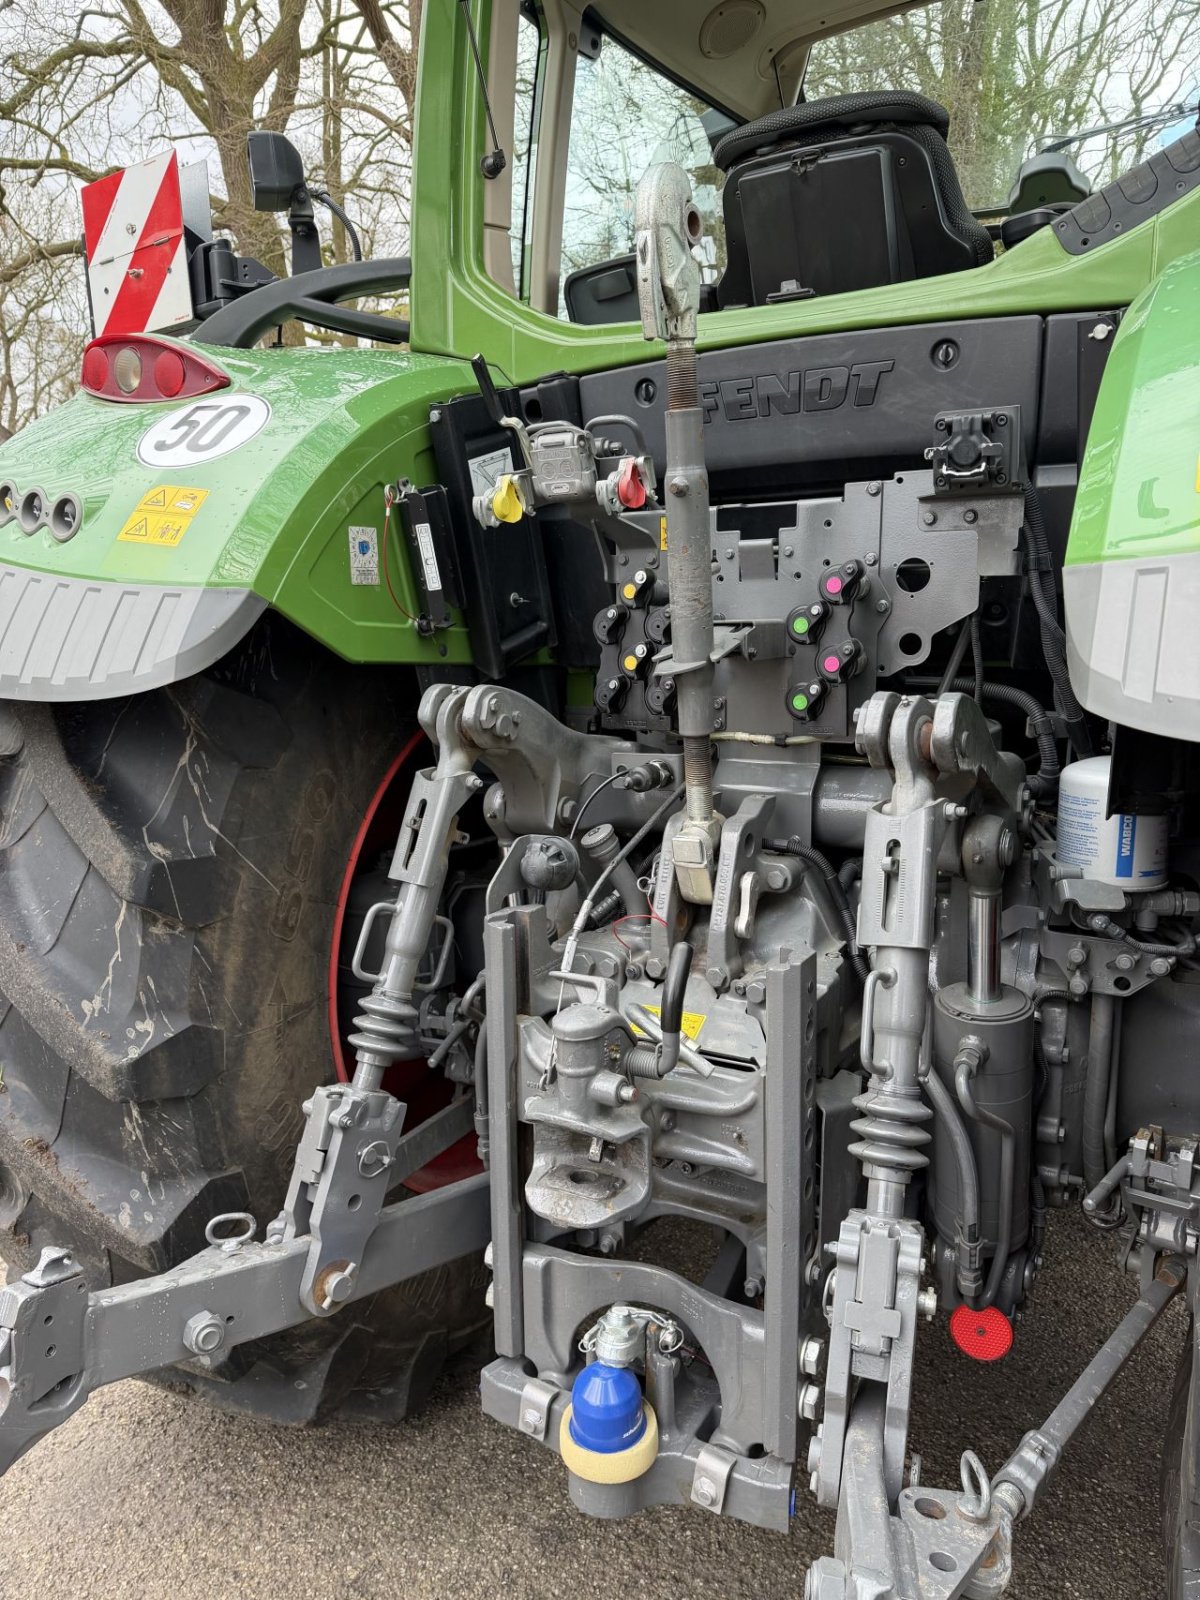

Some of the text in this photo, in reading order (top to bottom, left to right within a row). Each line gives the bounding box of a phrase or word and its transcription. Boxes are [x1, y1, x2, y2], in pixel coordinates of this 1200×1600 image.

[698, 360, 895, 424] FENDT
[154, 405, 251, 453] 50
[1121, 815, 1133, 857] WABCO
